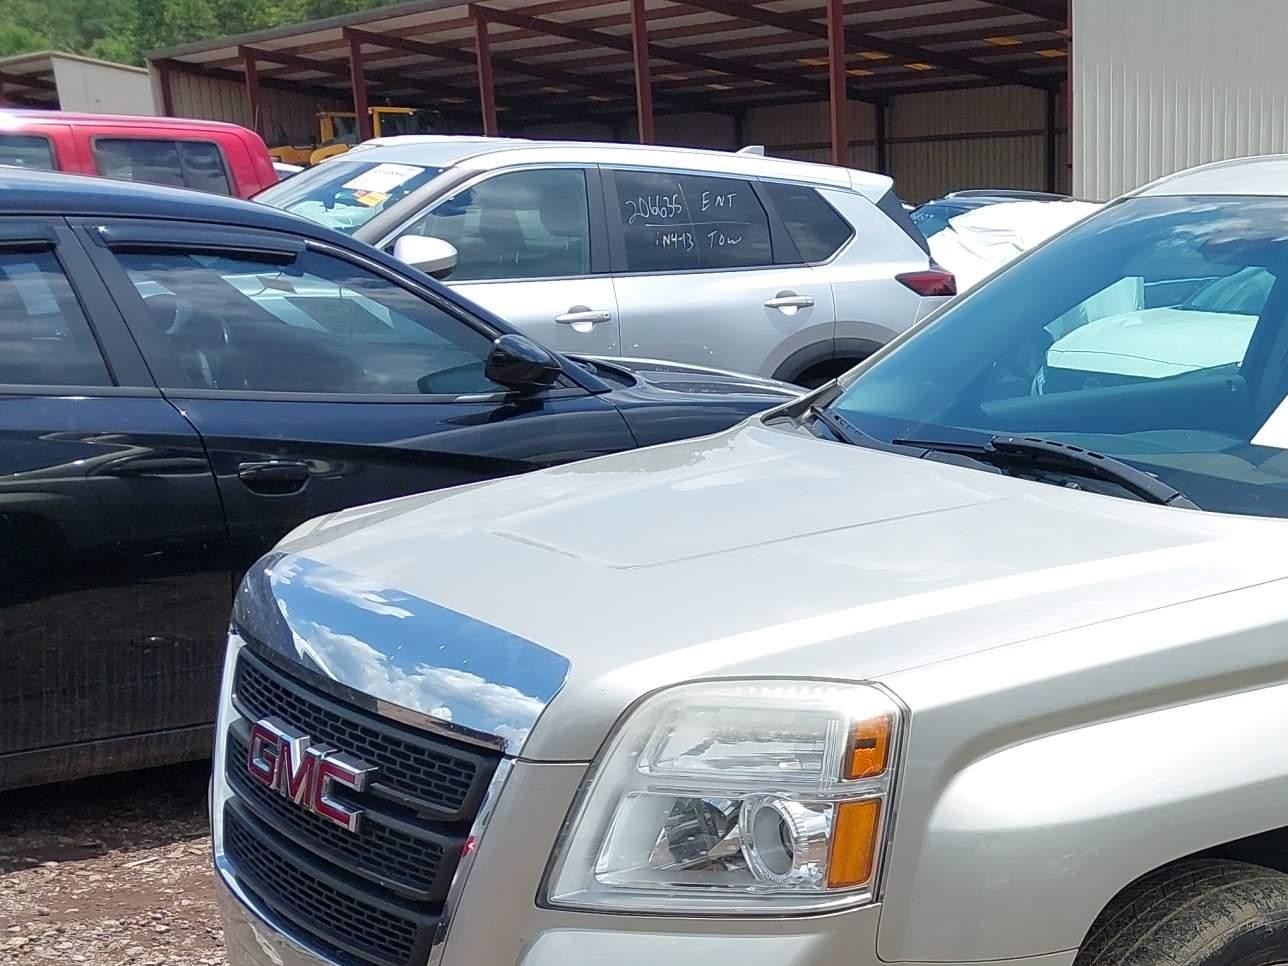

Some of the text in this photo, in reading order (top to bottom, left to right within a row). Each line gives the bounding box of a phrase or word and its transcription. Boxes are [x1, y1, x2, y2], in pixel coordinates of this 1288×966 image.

[625, 191, 737, 225] 206635 ENT
[248, 717, 378, 832] GMC
